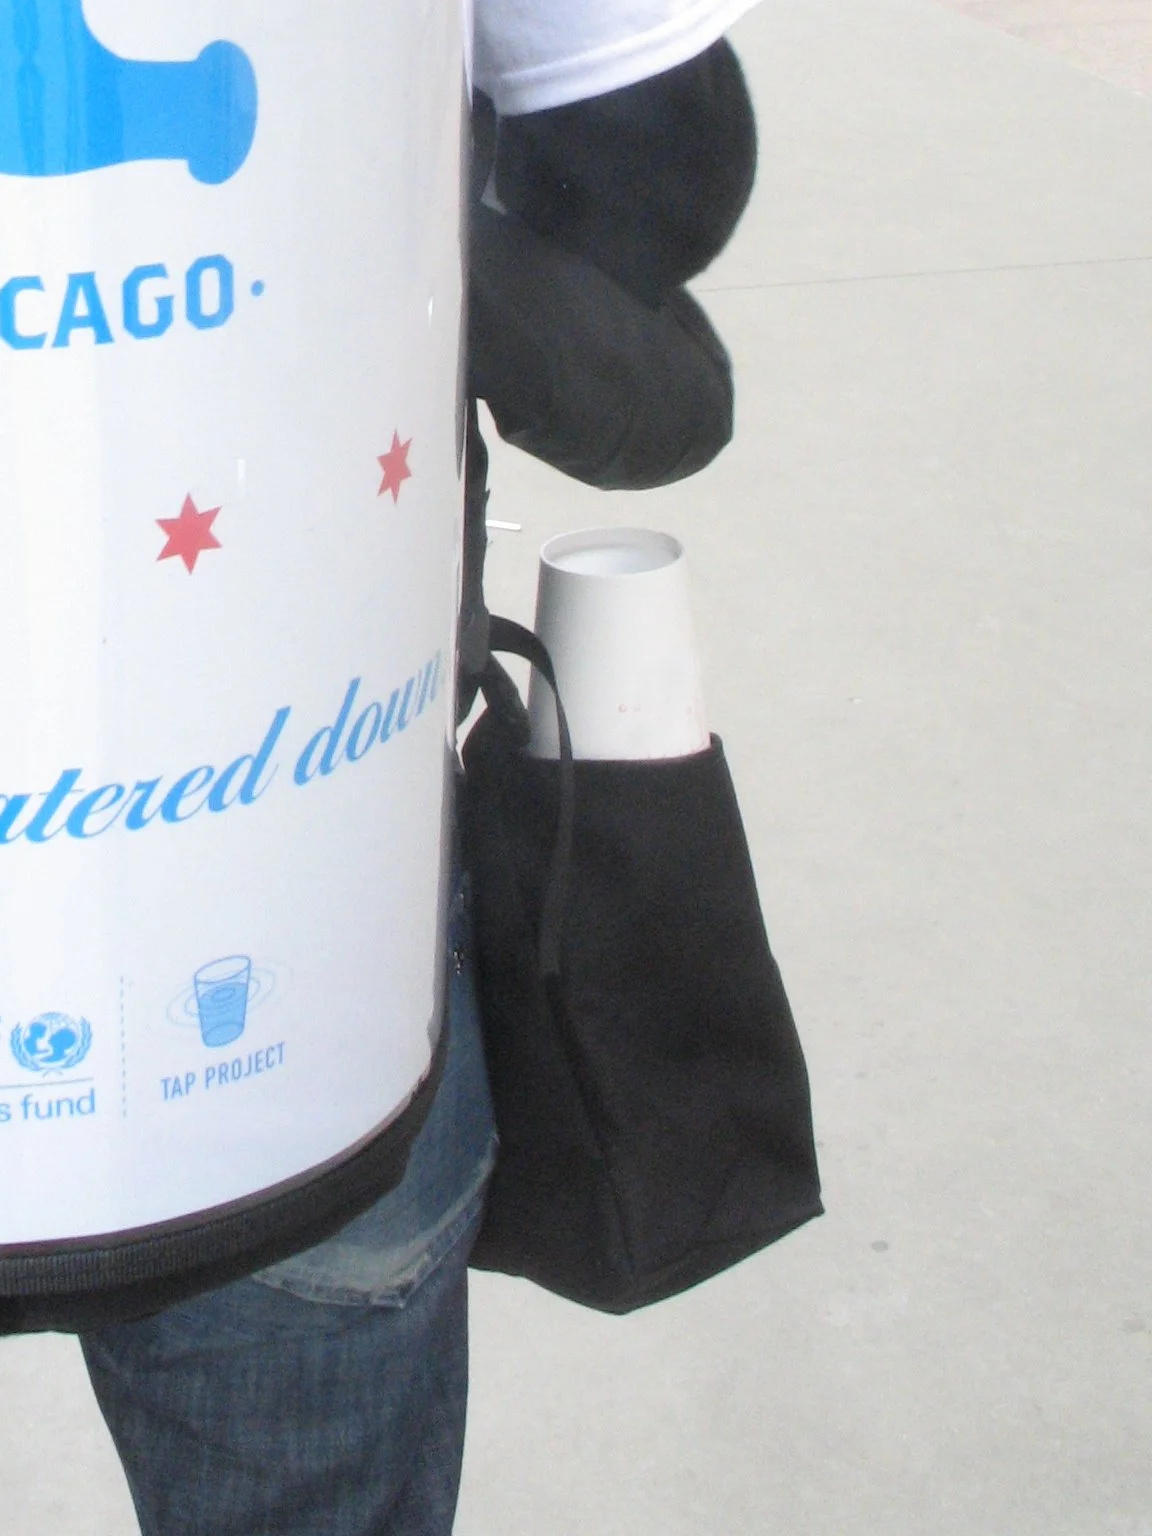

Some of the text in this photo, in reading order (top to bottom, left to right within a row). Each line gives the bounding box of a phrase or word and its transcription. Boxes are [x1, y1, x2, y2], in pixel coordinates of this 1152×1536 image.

[293, 647, 446, 787] down
[160, 1040, 286, 1101] TAP PROJECT
[19, 1086, 97, 1120] fund
